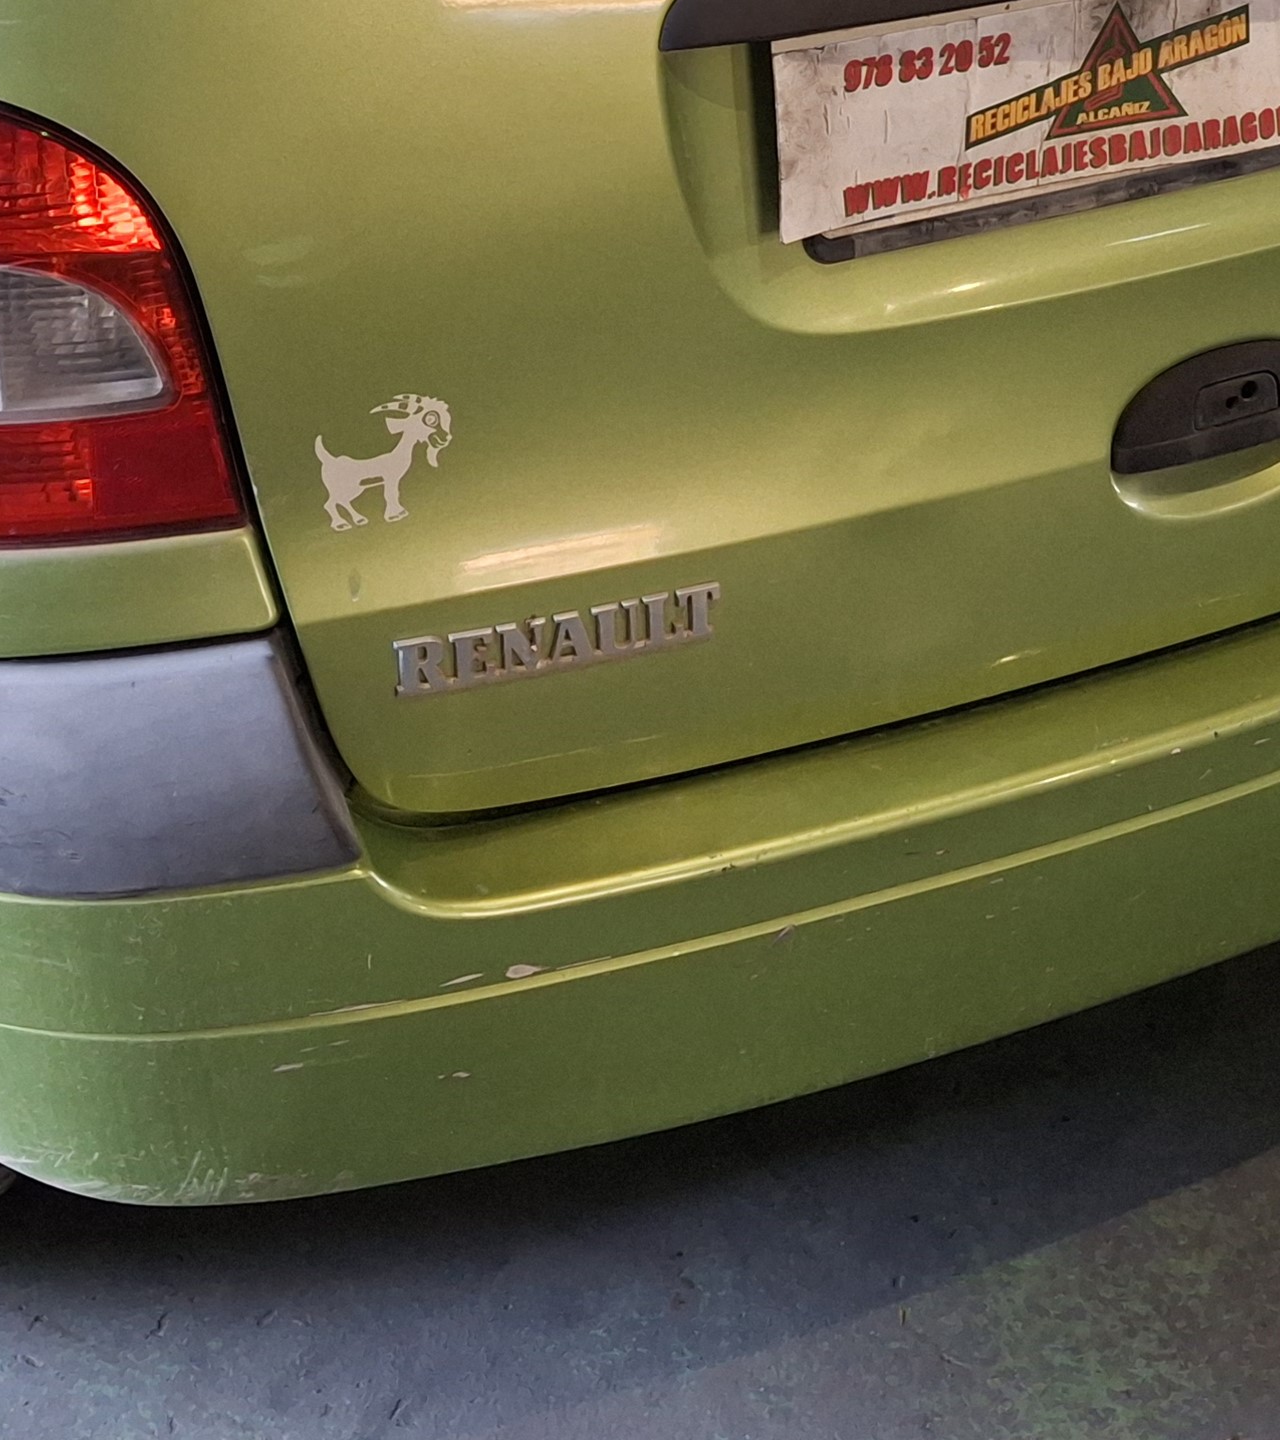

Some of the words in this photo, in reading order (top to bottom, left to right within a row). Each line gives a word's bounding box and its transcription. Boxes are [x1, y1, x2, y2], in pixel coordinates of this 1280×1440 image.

[844, 54, 893, 93] 978
[898, 46, 934, 84] 83
[938, 39, 974, 77] 20
[977, 32, 1012, 68] 52
[969, 71, 1093, 143] RECICLAJES
[1097, 47, 1153, 92] BAJO
[1157, 13, 1246, 69] ARAGÓN
[1076, 101, 1151, 125] ALCAÑIZ
[393, 581, 720, 697] RENAULT
